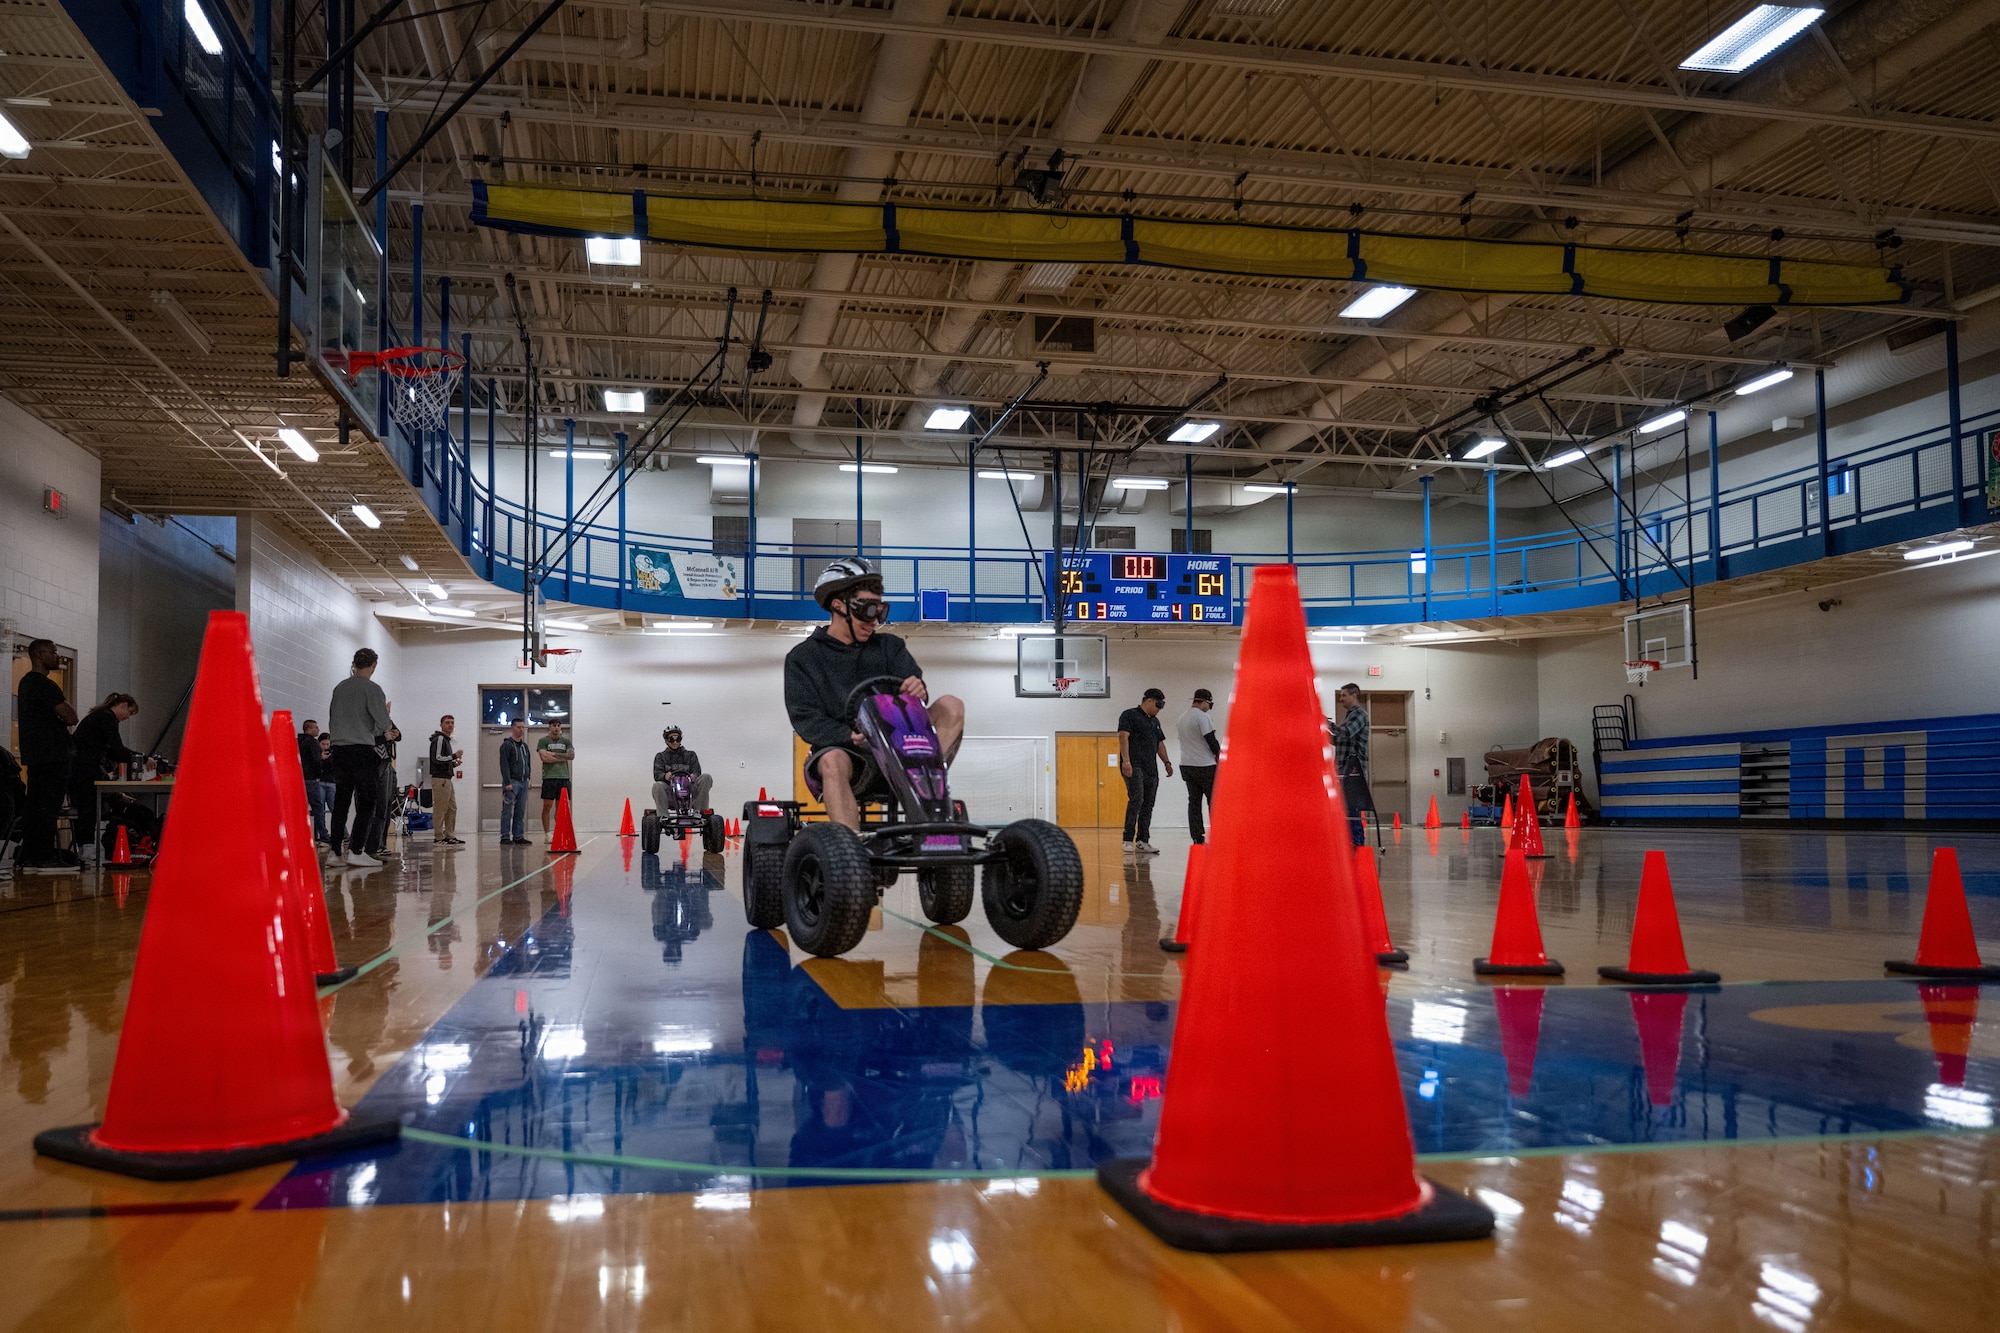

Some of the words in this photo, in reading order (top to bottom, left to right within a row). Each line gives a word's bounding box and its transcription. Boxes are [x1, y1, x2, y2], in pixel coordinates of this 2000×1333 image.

[1060, 558, 1093, 568] UEST
[1124, 556, 1154, 579] 0.0
[1187, 560, 1220, 571] HOME
[642, 579, 662, 591] TALK
[1114, 586, 1144, 594] PERIOD
[1198, 573, 1224, 596] 64
[1078, 601, 1089, 619] 0
[1096, 602, 1107, 619] 3
[1171, 603, 1183, 621] 4
[1192, 604, 1203, 621] 0
